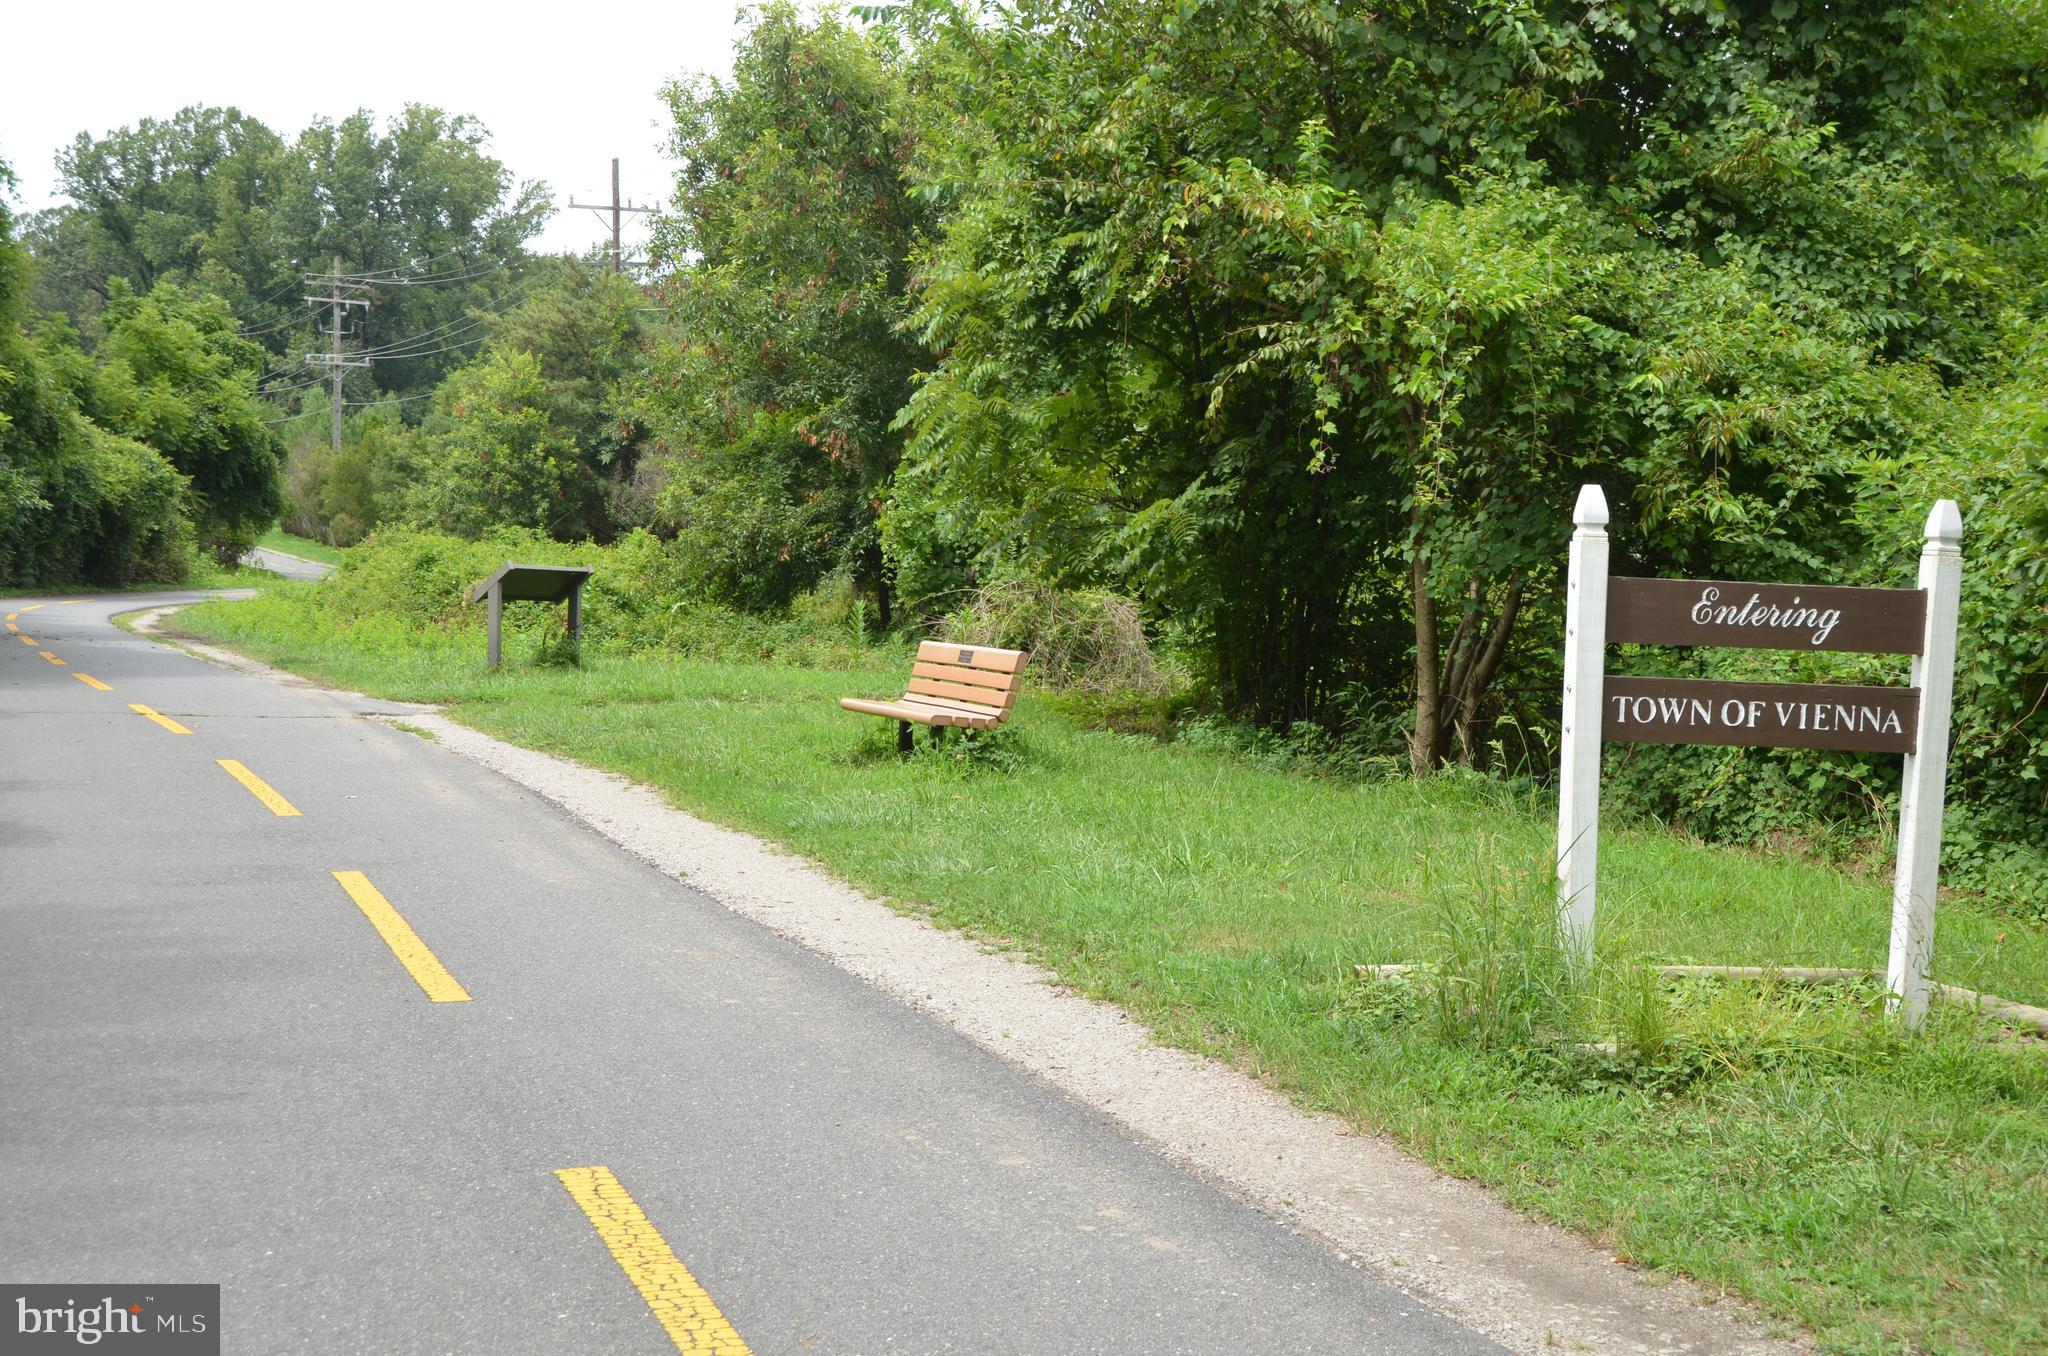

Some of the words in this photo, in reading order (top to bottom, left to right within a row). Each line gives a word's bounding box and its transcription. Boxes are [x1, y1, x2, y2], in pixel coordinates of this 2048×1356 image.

[1691, 586, 1841, 645] Entering
[1611, 695, 1713, 726] TOWN
[1720, 699, 1767, 728] OF
[1774, 701, 1903, 734] VIENNA
